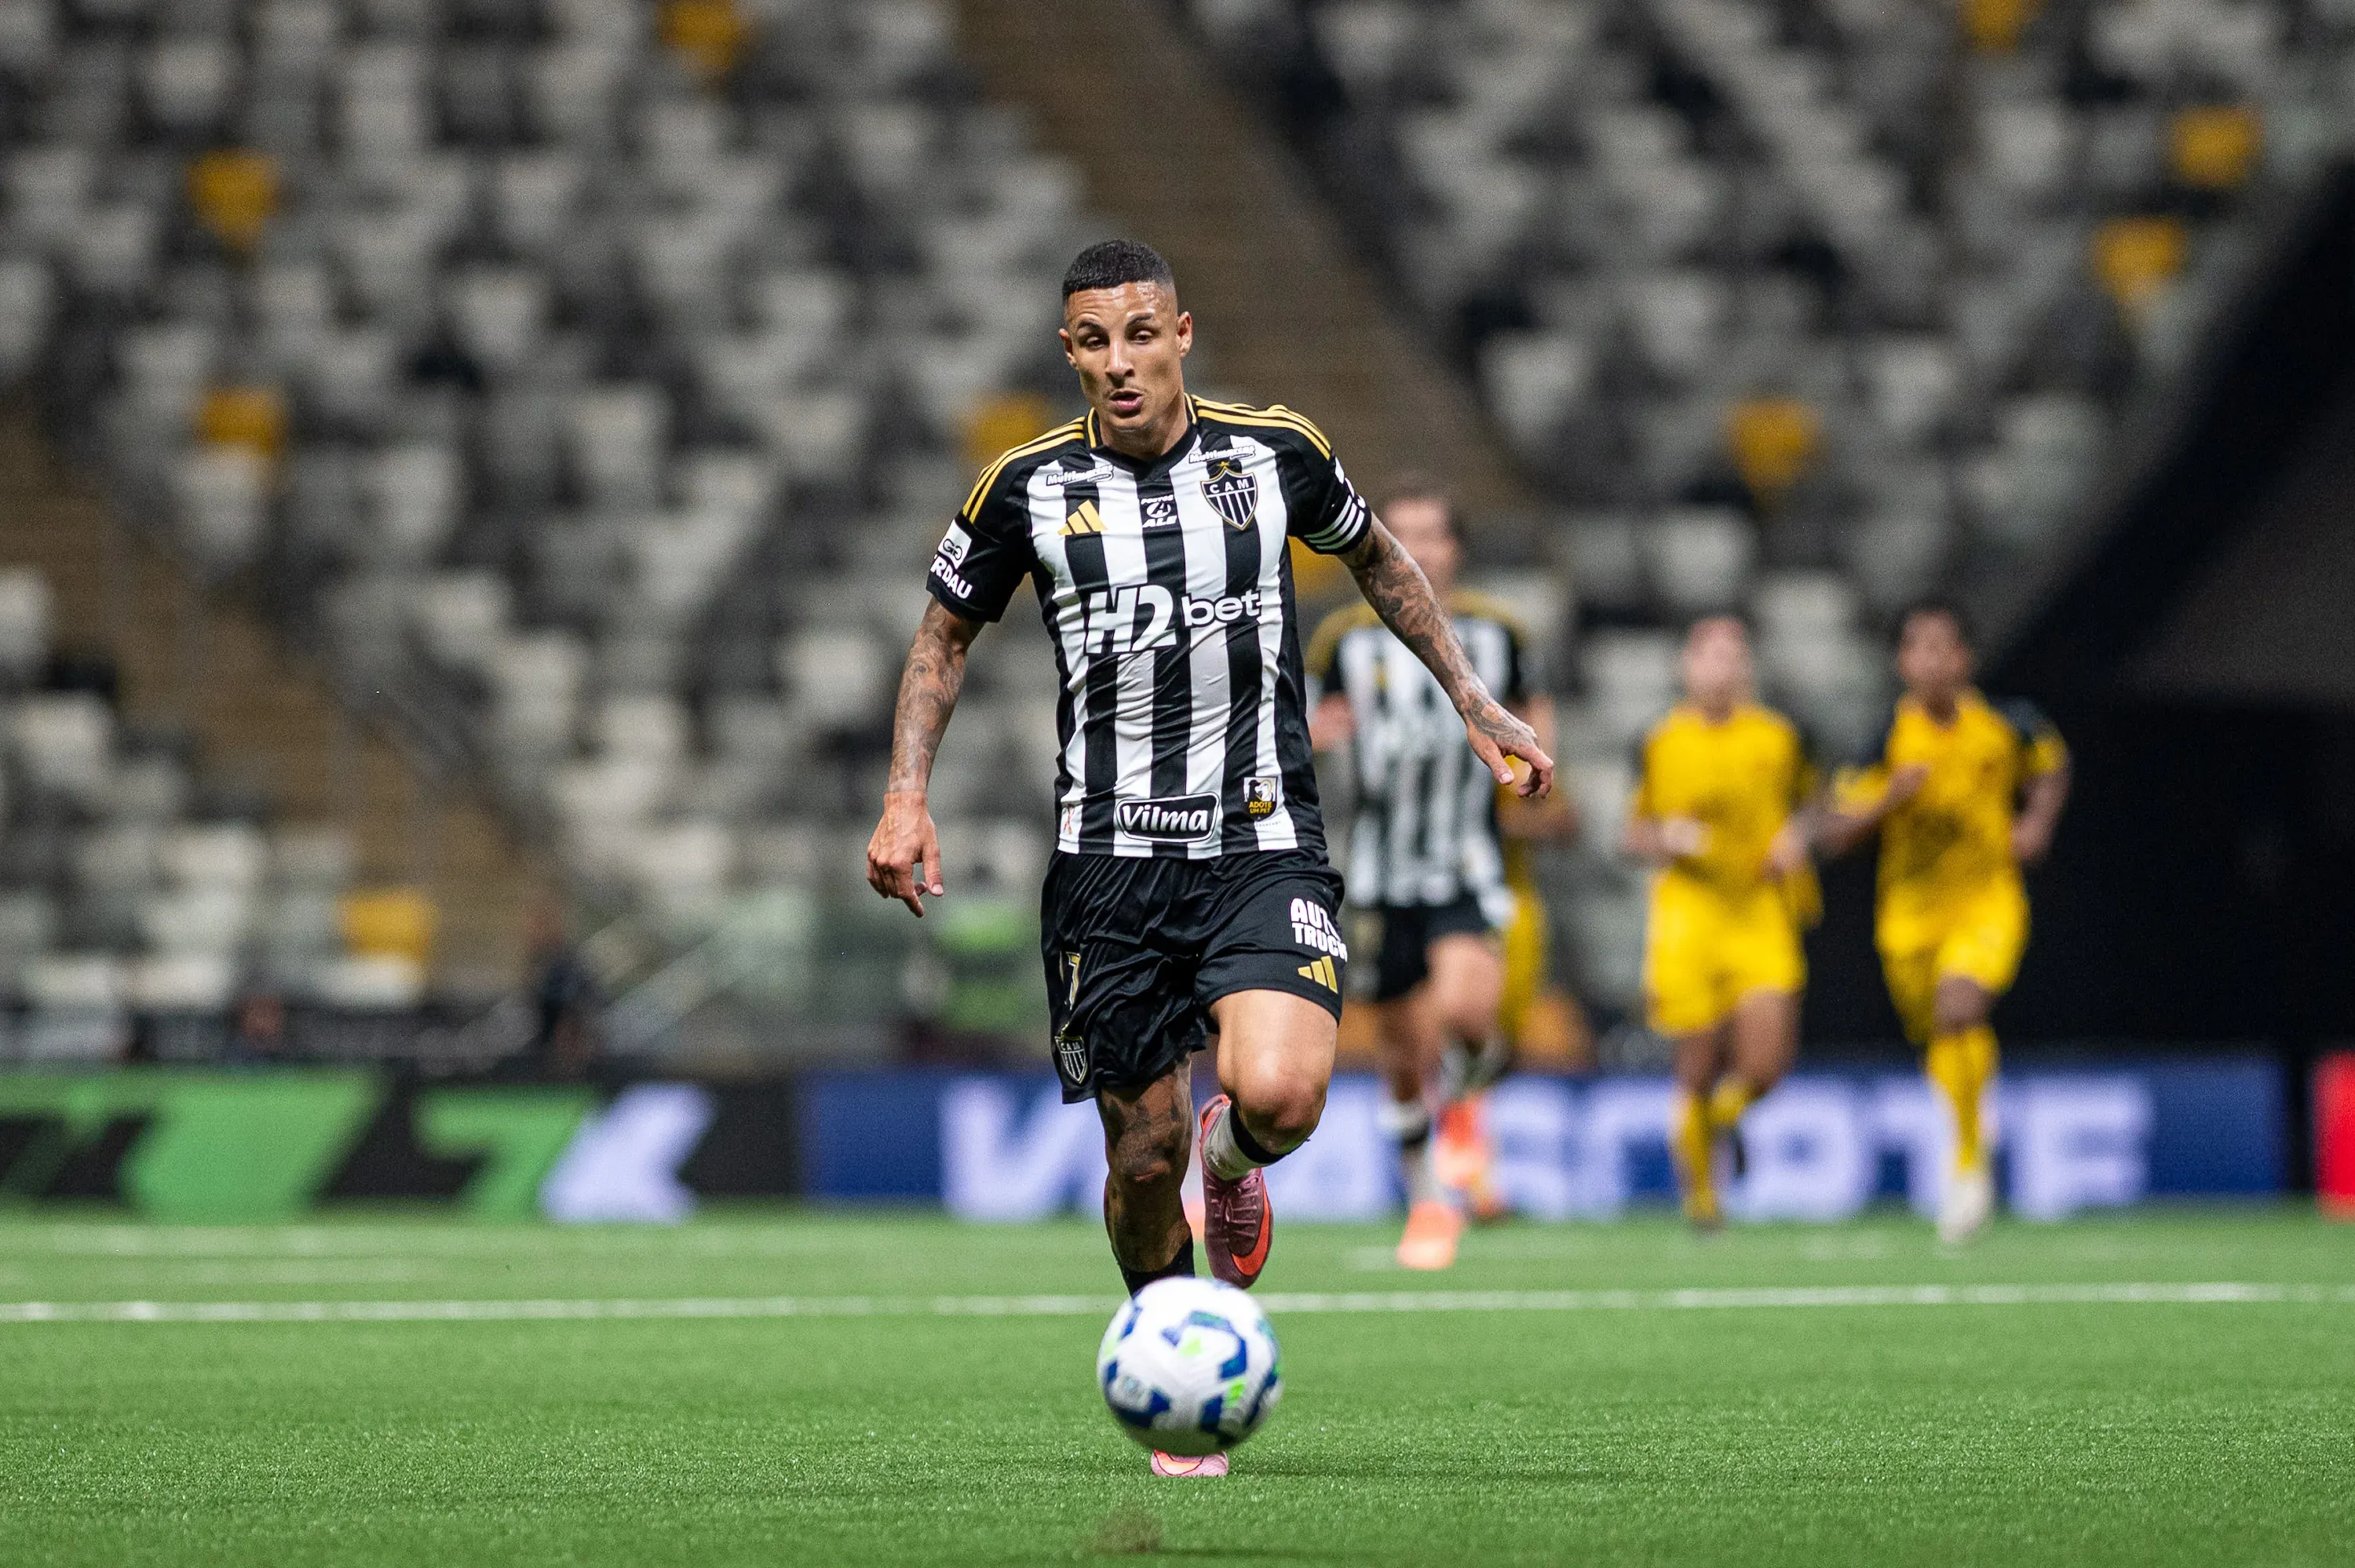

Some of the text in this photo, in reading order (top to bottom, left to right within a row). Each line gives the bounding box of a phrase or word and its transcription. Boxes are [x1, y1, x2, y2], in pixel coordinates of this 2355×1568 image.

[1209, 479, 1250, 494] CAM
[1142, 515, 1178, 527] ALE
[930, 554, 973, 599] RDAU
[1123, 804, 1208, 832] Vilma
